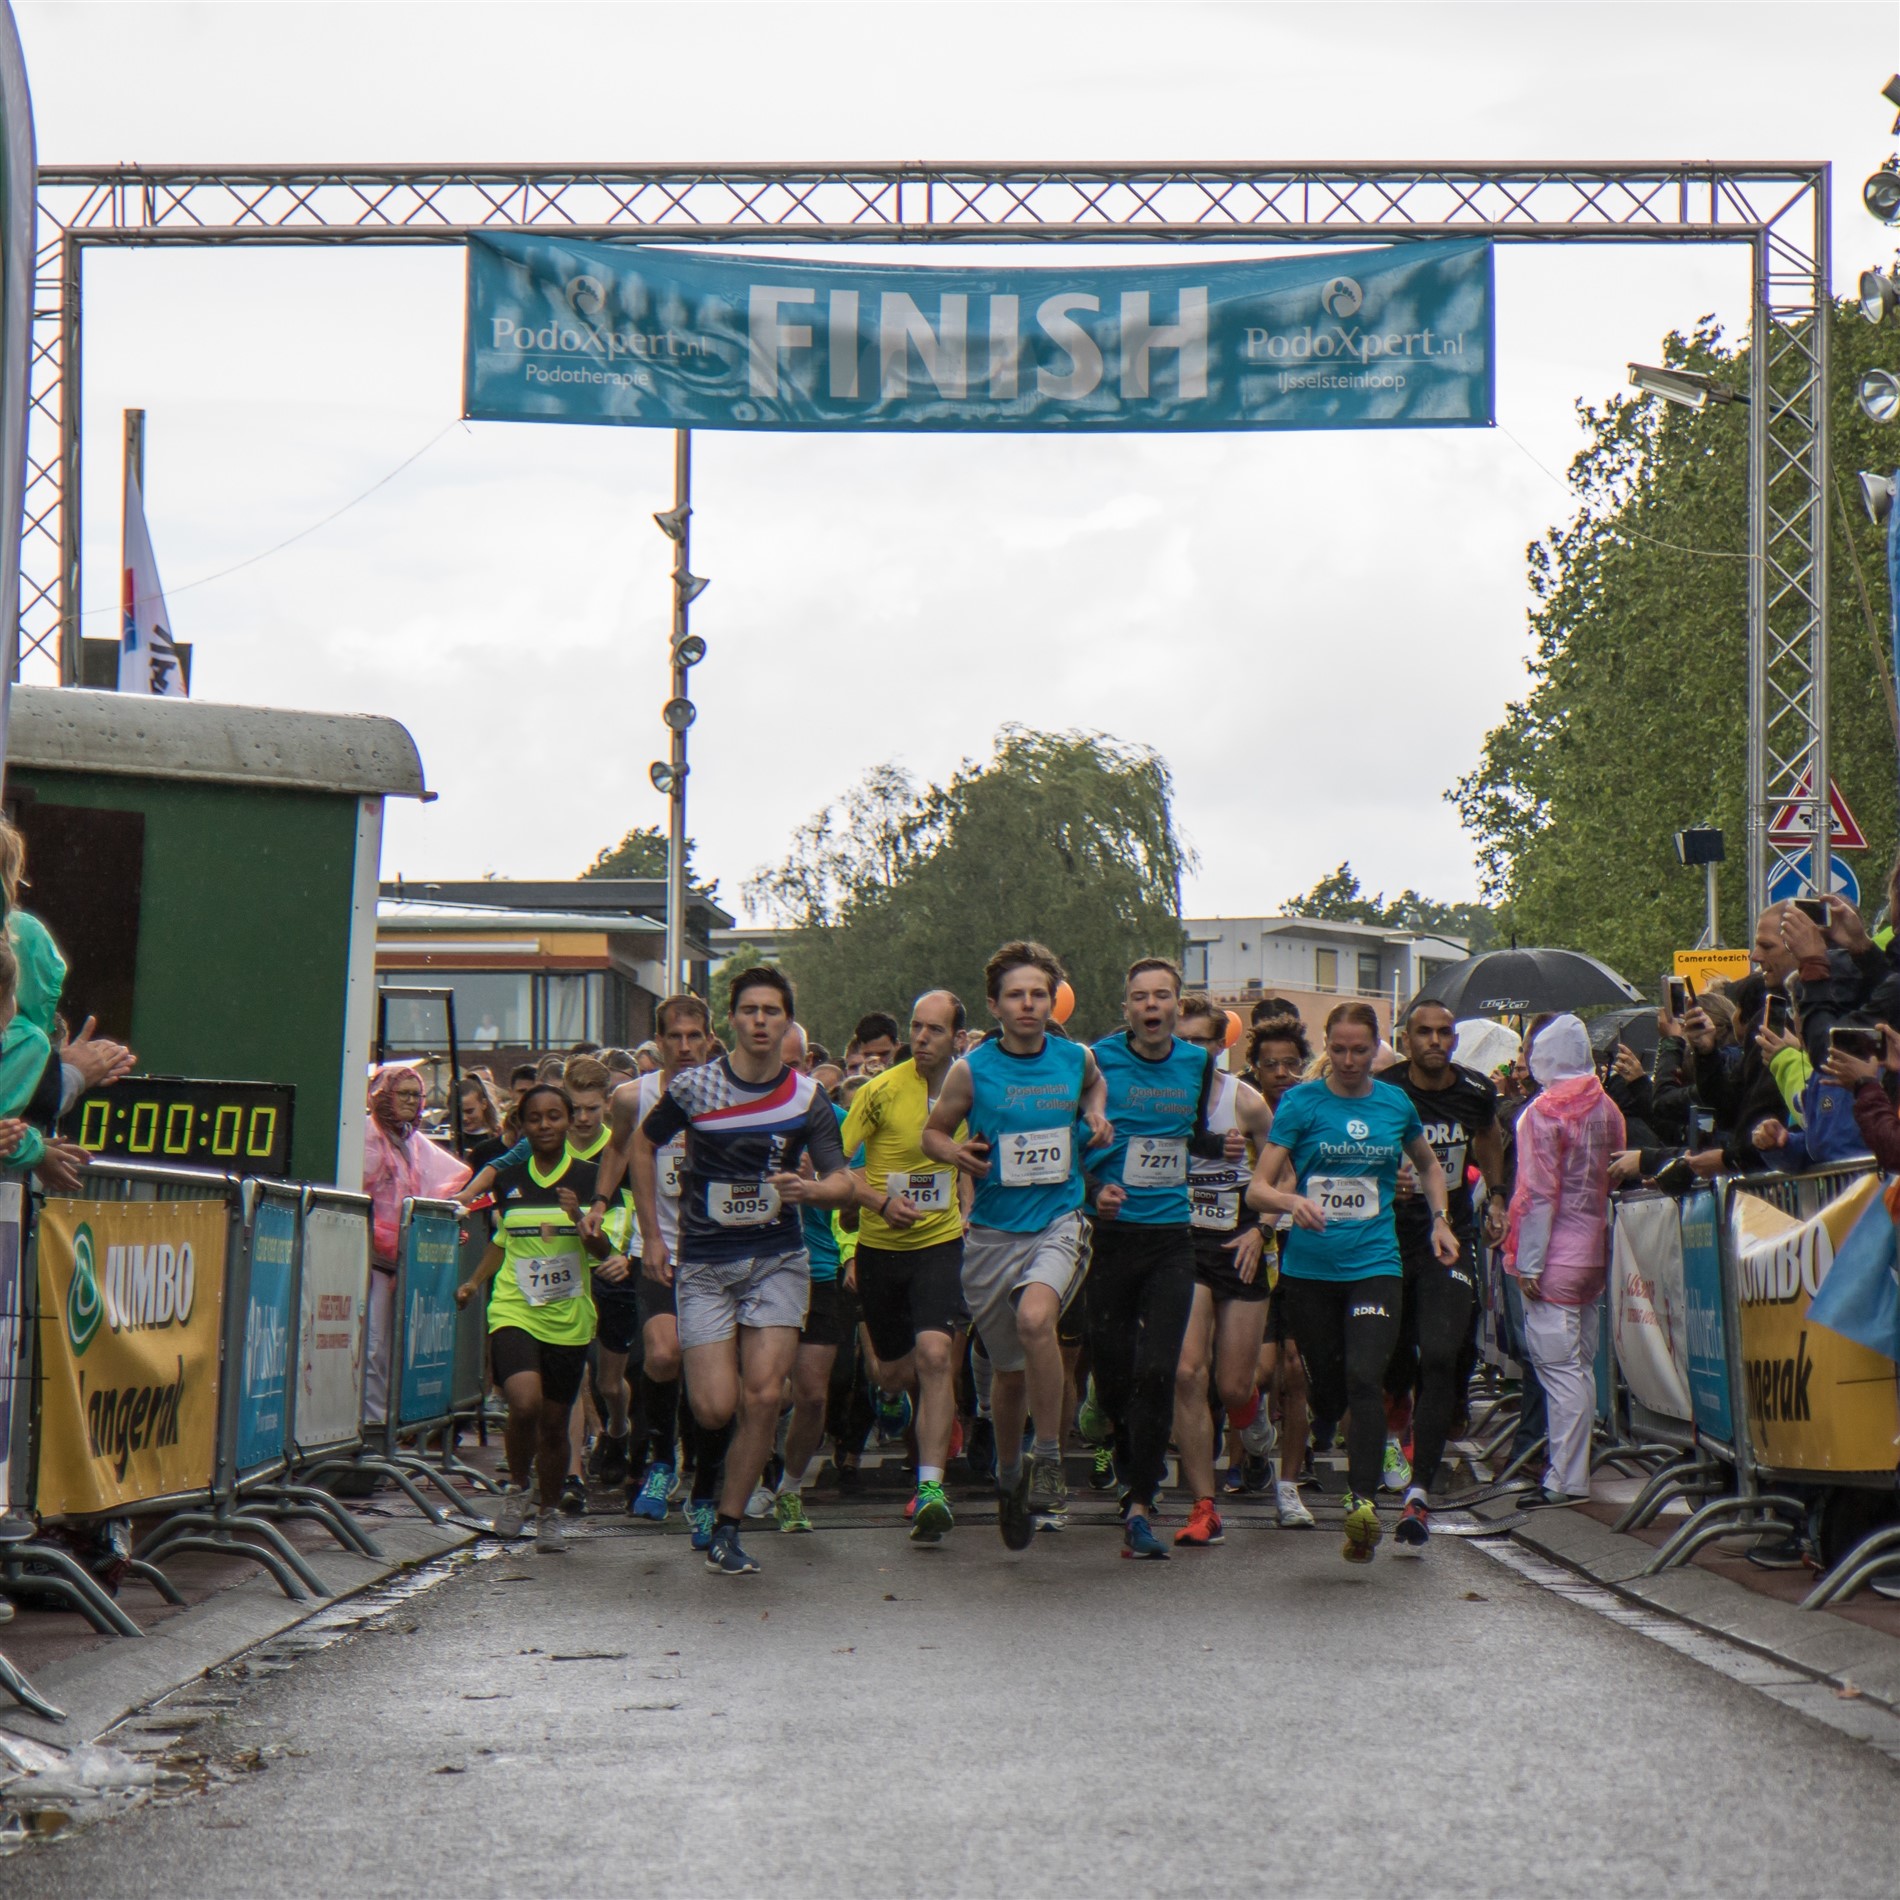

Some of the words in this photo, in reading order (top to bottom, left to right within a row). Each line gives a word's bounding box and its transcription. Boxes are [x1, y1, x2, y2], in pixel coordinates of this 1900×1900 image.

[491, 317, 706, 361] PodoXpert.nl
[748, 284, 1208, 400] FINISH
[1244, 326, 1463, 364] PodoXpert.nl
[525, 363, 649, 388] Podotherapie
[1278, 371, 1406, 394] IJsselsteinloop
[78, 1100, 277, 1157] 0:00:00
[1350, 1123, 1366, 1135] 25
[1422, 1122, 1469, 1145] DRA.
[1014, 1147, 1061, 1165] 7270
[1319, 1141, 1394, 1157] PodoXpert
[1140, 1154, 1178, 1168] 7271
[733, 1185, 758, 1194] BODY
[1194, 1190, 1217, 1200] BODY
[722, 1199, 769, 1214] 3095
[1320, 1193, 1366, 1208] 7040
[105, 1241, 195, 1330] JUMBO
[529, 1269, 571, 1287] 7183
[1353, 1306, 1390, 1317] RDRA.
